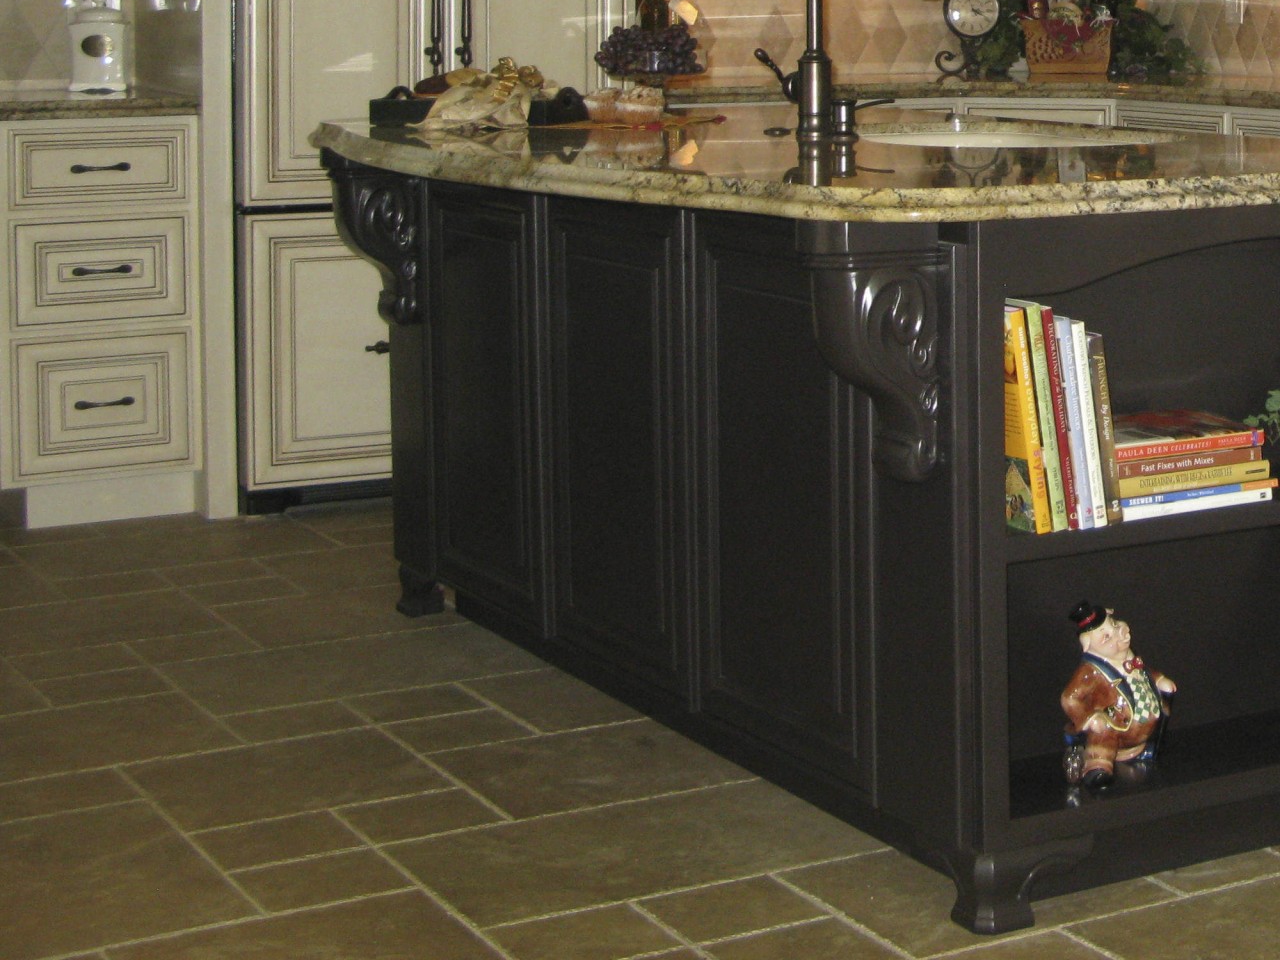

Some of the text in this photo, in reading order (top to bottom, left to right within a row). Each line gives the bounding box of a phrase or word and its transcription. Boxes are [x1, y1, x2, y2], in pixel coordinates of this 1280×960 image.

[1047, 322, 1059, 375] DECORATING
[1056, 394, 1066, 433] HOLIDAYS
[1065, 335, 1075, 364] Charles
[1072, 397, 1081, 430] Interiors
[1093, 355, 1107, 400] FRENCH
[1101, 403, 1109, 414] By
[1018, 326, 1026, 349] susie
[1026, 388, 1039, 444] everyday
[1033, 449, 1045, 499] styling
[1117, 448, 1144, 458] PAULA
[1147, 446, 1169, 454] DEEN
[1170, 441, 1212, 451] CELEBRATES!
[1141, 457, 1214, 472] Fast Fixes with Mixes
[1139, 476, 1175, 488] ENTERTAINING
[1176, 473, 1189, 483] WITH
[1129, 495, 1164, 505] SKEWER IT!
